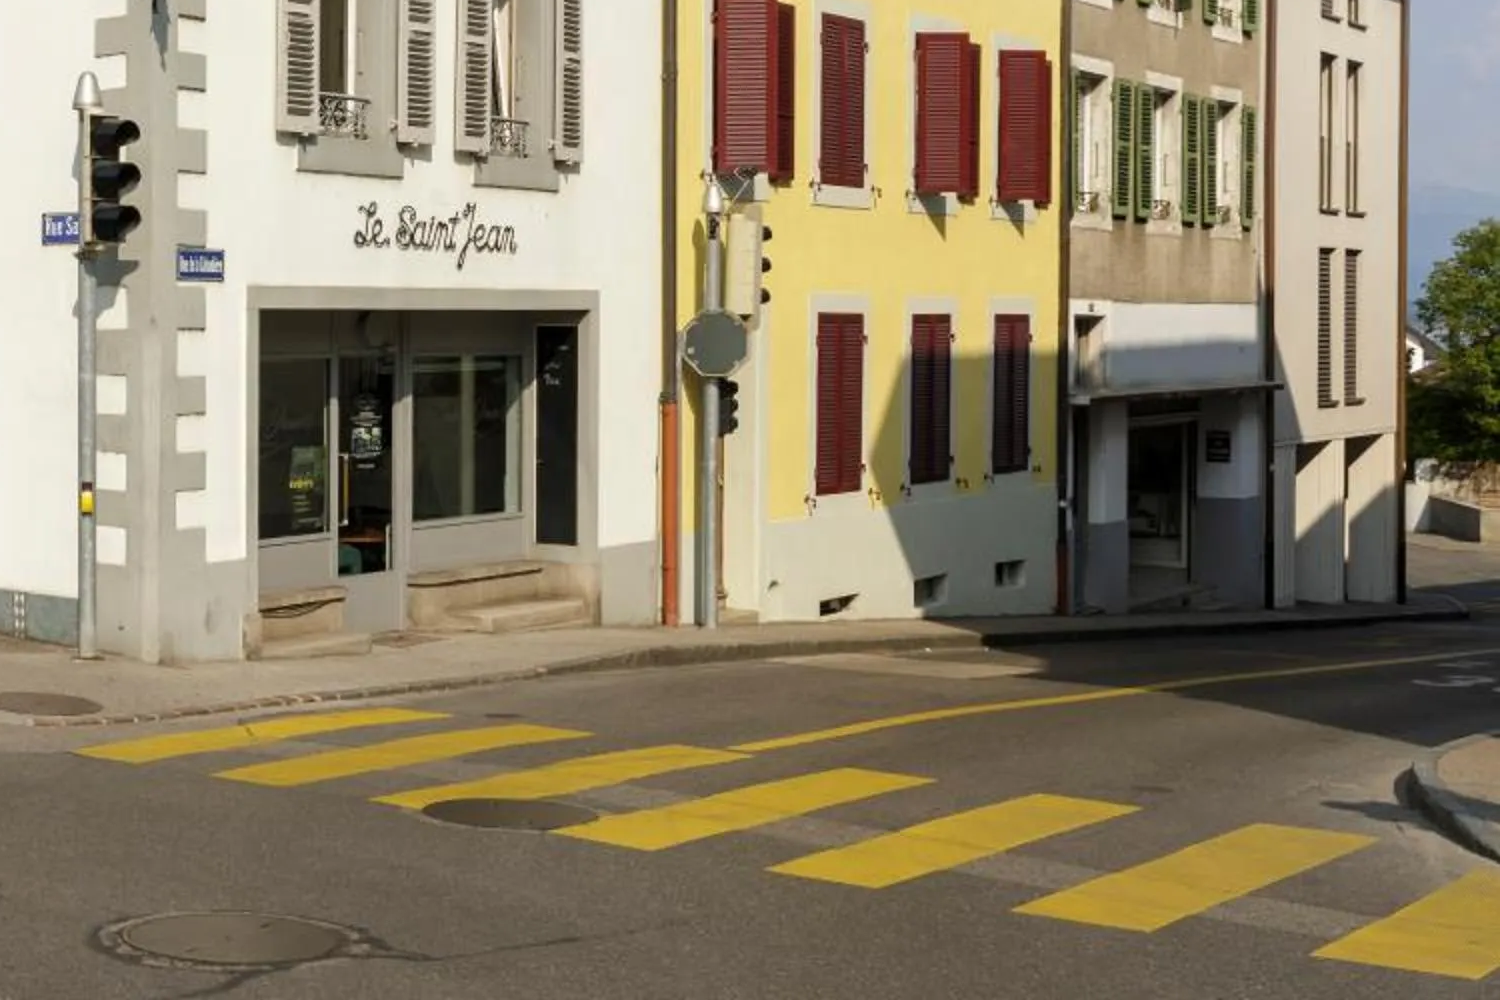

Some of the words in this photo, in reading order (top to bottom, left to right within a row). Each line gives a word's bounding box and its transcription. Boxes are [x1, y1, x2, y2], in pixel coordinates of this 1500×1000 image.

[45, 217, 63, 236] Rue
[65, 215, 80, 236] Sa
[353, 201, 390, 248] Le
[395, 205, 461, 250] Saint
[457, 202, 517, 271] Jean
